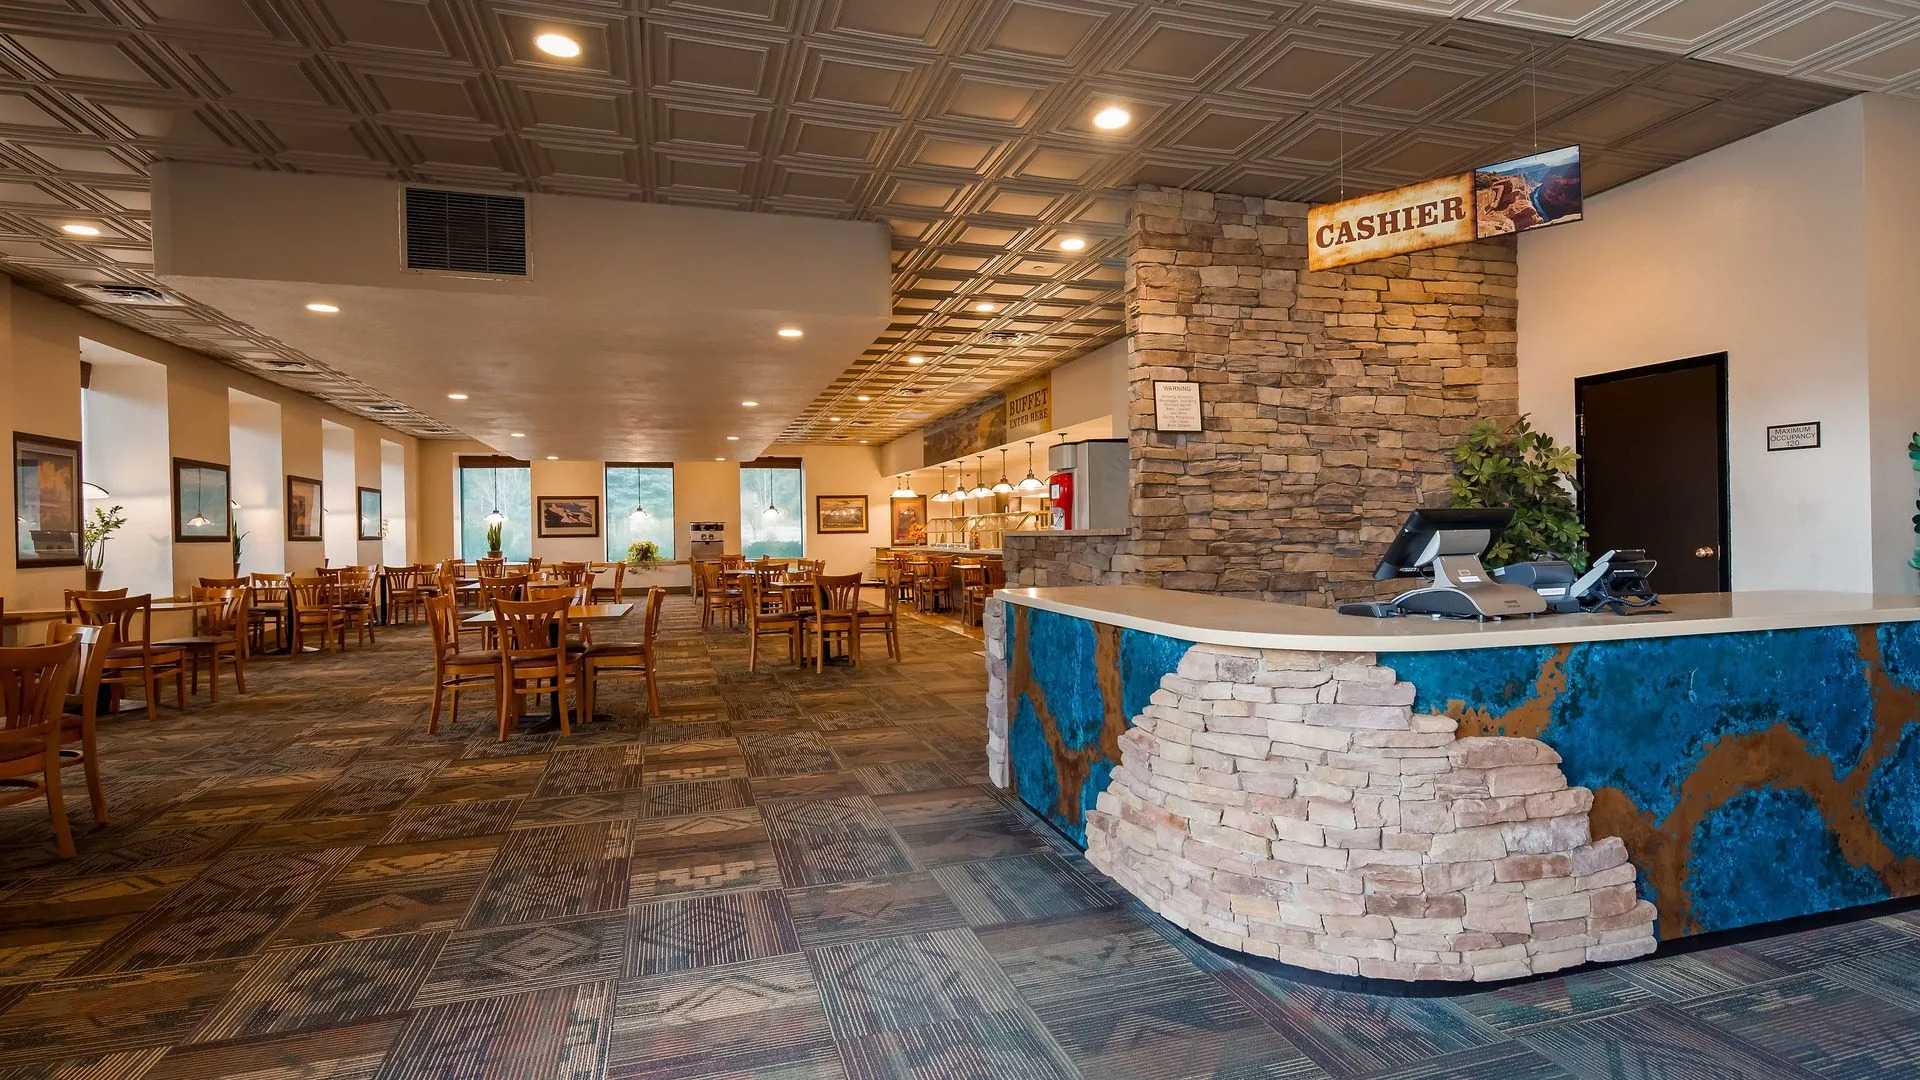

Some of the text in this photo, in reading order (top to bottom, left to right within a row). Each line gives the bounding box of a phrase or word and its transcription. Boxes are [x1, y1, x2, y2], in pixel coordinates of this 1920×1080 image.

[1315, 196, 1466, 249] CASHIER
[1009, 387, 1048, 417] BUFFET
[1009, 408, 1048, 430] ENTER HERE
[1770, 432, 1816, 442] OCCUPANCY
[1774, 426, 1811, 435] MAXIMUM
[1786, 439, 1800, 447] 120
